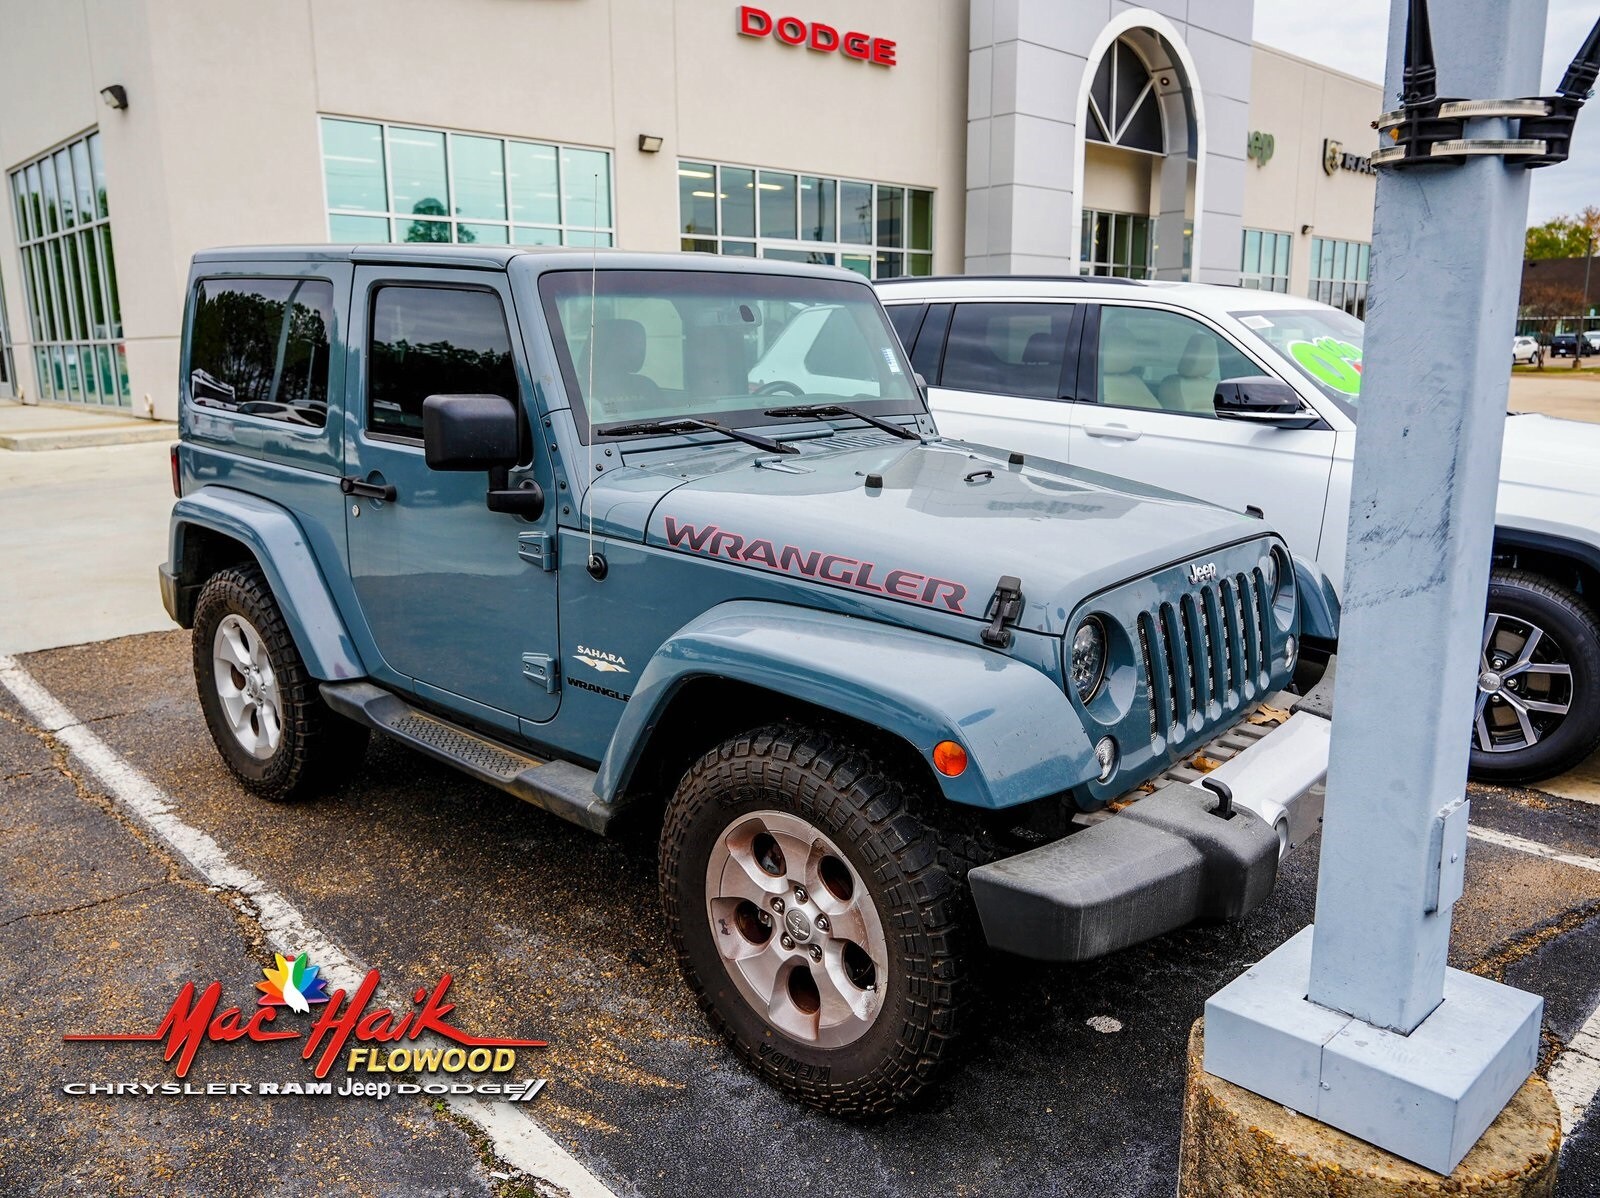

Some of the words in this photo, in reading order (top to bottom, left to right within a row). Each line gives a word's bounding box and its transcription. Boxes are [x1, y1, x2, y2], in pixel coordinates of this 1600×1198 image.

[736, 5, 897, 67] DODGE
[1248, 131, 1274, 167] ep
[664, 515, 969, 614] WRANGLER
[1188, 562, 1216, 585] Jeep
[577, 645, 626, 666] SAHARA
[567, 676, 632, 703] WRANGLE
[759, 1041, 832, 1082] KENDA
